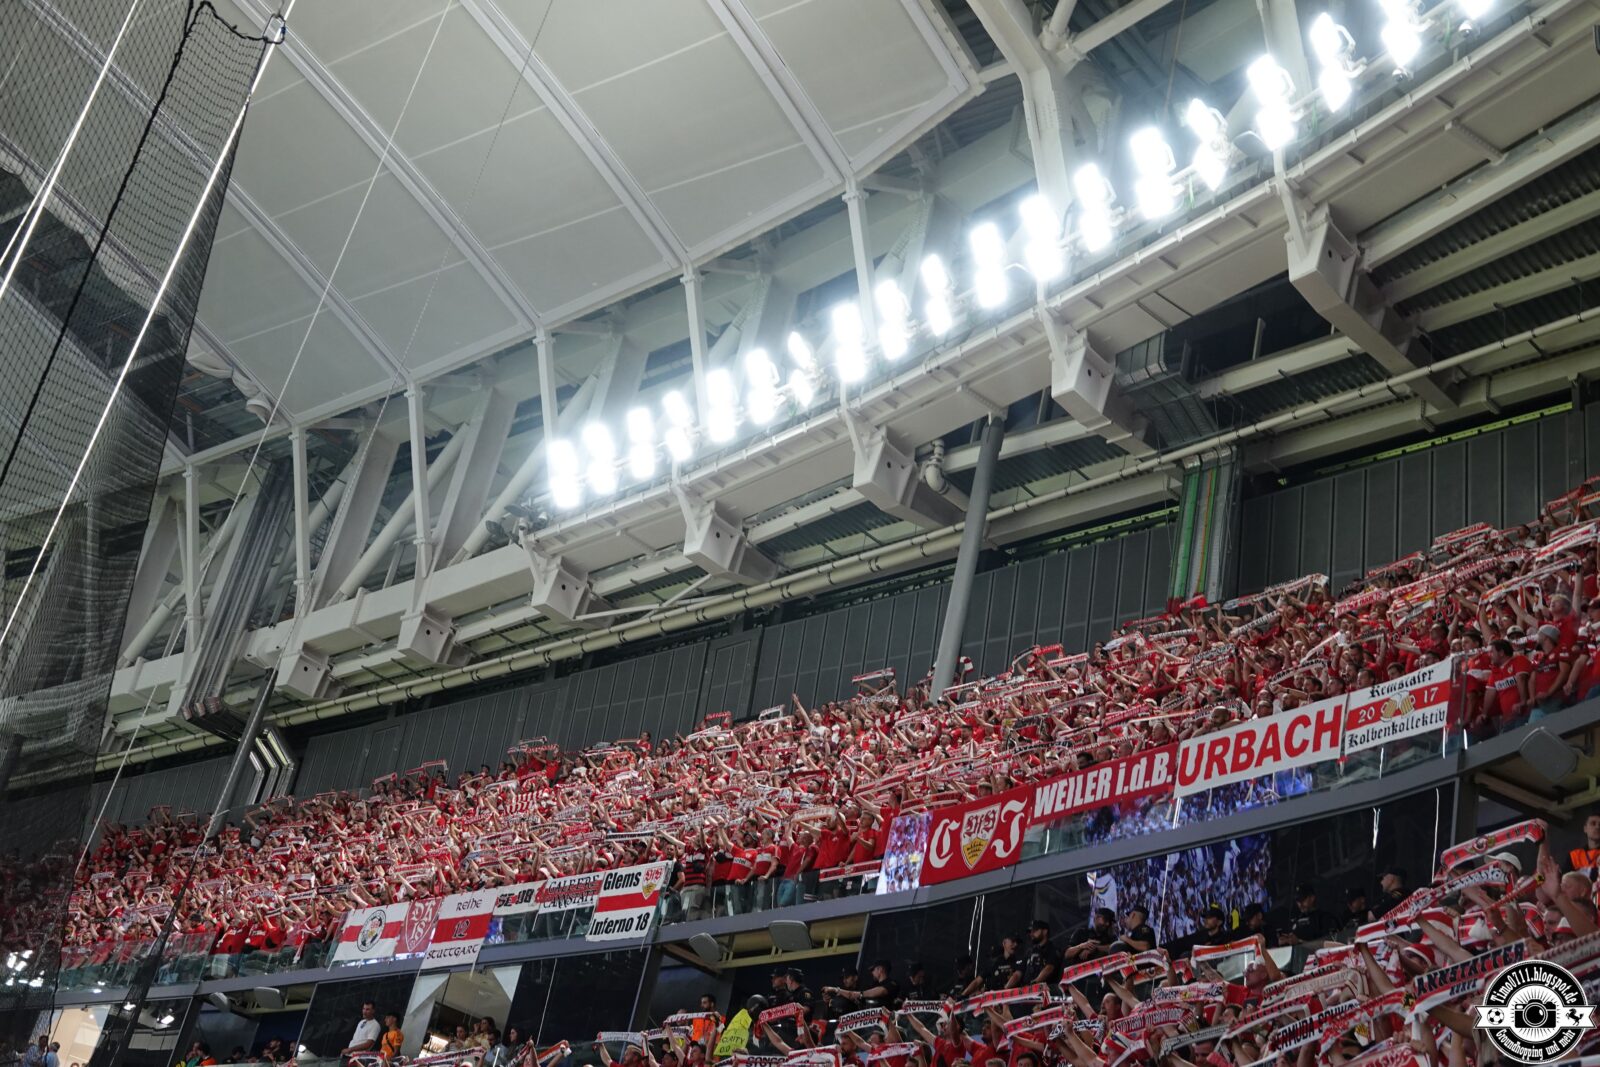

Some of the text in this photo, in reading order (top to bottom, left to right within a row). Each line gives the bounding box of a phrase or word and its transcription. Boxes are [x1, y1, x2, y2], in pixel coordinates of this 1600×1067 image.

[1358, 687, 1439, 724] 20 17
[1178, 704, 1343, 787] URBACH
[1348, 708, 1445, 748] Kolbenkollektiv
[1033, 751, 1173, 818] WEILER i.d.B.
[603, 871, 642, 891] Glems
[452, 919, 470, 939] 12
[589, 912, 650, 936] Inferno 18
[1415, 941, 1525, 997] ANNSTATTER
[841, 1008, 884, 1024] CONCORDIA
